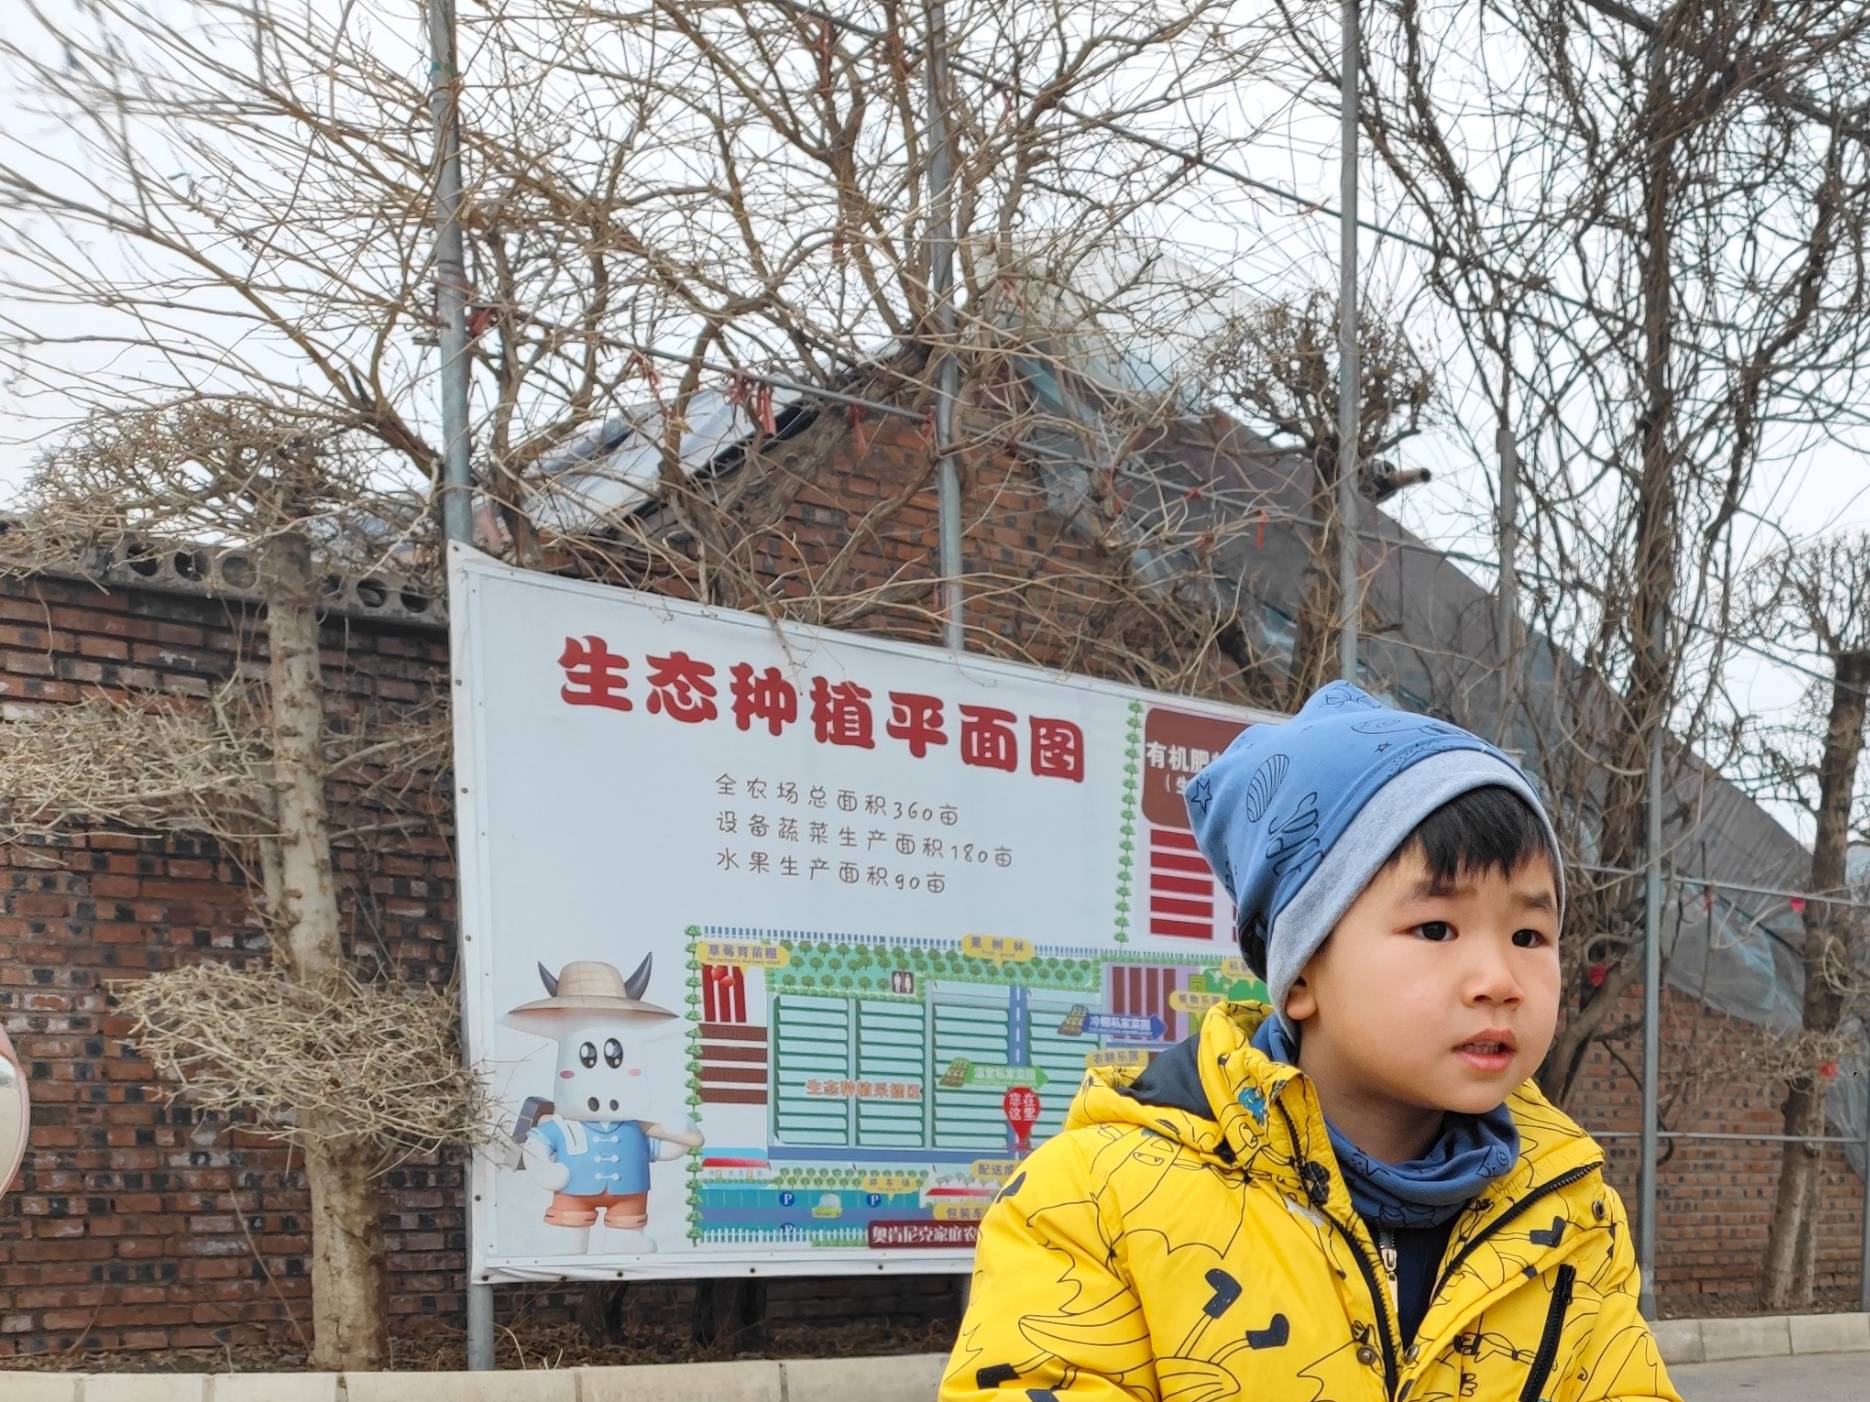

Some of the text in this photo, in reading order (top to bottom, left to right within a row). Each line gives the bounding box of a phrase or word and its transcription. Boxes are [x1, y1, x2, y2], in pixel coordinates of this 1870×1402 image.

[558, 635, 1085, 783] 生态种植平面图
[715, 772, 959, 826] 全农场总面积360亩
[715, 810, 1013, 868] 设备蔬菜生产面积180亩
[715, 846, 947, 894] 水果生产面积90亩
[1009, 1092, 1037, 1107] 您在
[1009, 1106, 1036, 1121] 这里
[783, 1193, 793, 1206] P
[870, 1194, 879, 1206] P
